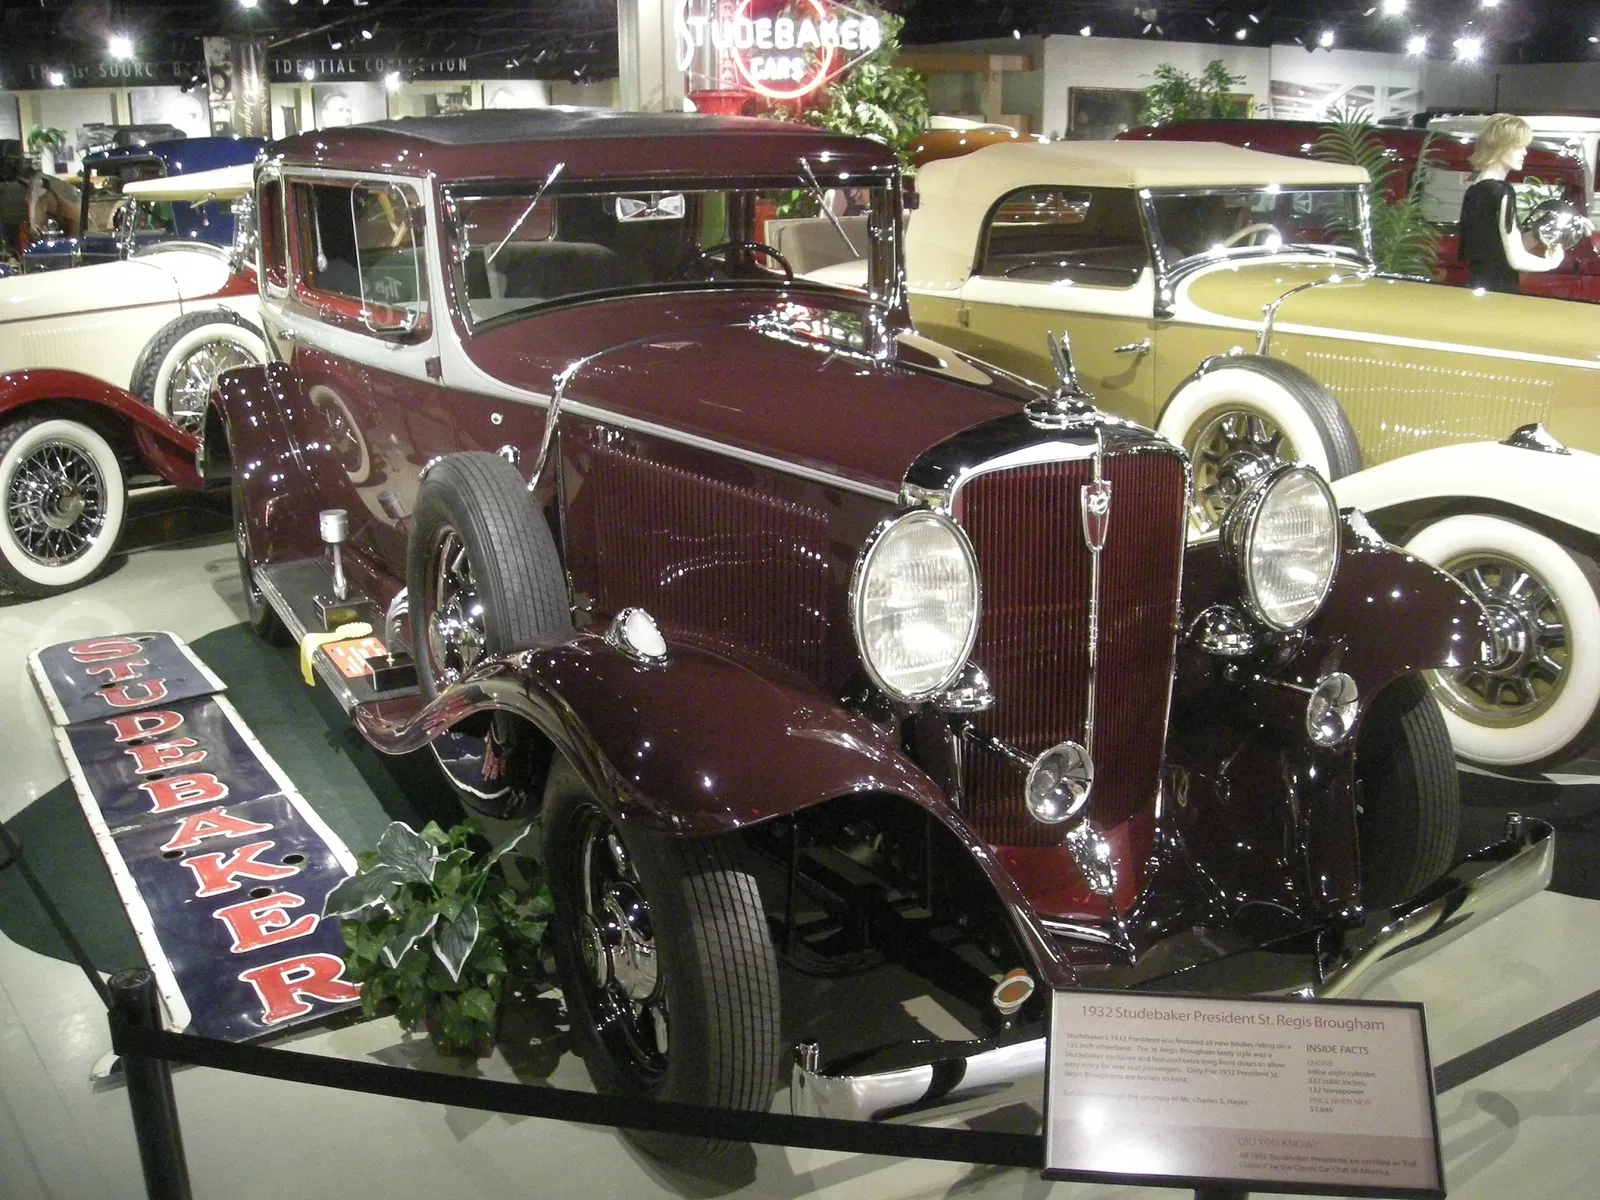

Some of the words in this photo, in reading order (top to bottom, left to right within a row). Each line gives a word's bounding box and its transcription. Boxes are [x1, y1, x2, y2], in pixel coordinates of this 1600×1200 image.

[673, 0, 882, 72] STUDEBAKER
[99, 62, 153, 79] SOURC
[750, 56, 805, 82] CARS
[67, 634, 364, 1027] STUDEBAKER
[1082, 1005, 1113, 1018] 1932
[1115, 1006, 1191, 1021] Studebaker
[1194, 1010, 1256, 1024] President
[1258, 1014, 1274, 1026] St.
[1276, 1014, 1313, 1030] Regis
[1314, 1016, 1386, 1032] Brougham
[1176, 1038, 1204, 1046] featured
[1255, 1042, 1275, 1050] riding
[1306, 1044, 1338, 1054] INSIDE
[1340, 1045, 1370, 1055] FACTS
[1064, 1050, 1104, 1060] Studebaker
[1152, 1056, 1181, 1064] featured
[1179, 1048, 1215, 1056] Brougham
[1217, 1050, 1234, 1058] body
[1236, 1050, 1252, 1058] style
[1307, 1058, 1334, 1067] ENGINE
[1186, 1066, 1205, 1074] Only
[1136, 1074, 1160, 1082] known
[1323, 1087, 1364, 1095] horsepower
[1140, 1094, 1170, 1103] courtesy
[1193, 1096, 1218, 1104] Charles
[1330, 1096, 1352, 1105] WHEN
[1354, 1098, 1372, 1106] NEW
[1238, 1136, 1256, 1146] DID
[1258, 1138, 1280, 1148] YOU
[1268, 1154, 1308, 1163] Studebaker
[1310, 1156, 1348, 1164] Presidents
[1362, 1158, 1391, 1166] certified
[1270, 1164, 1279, 1172] by
[1332, 1166, 1349, 1174] Club
